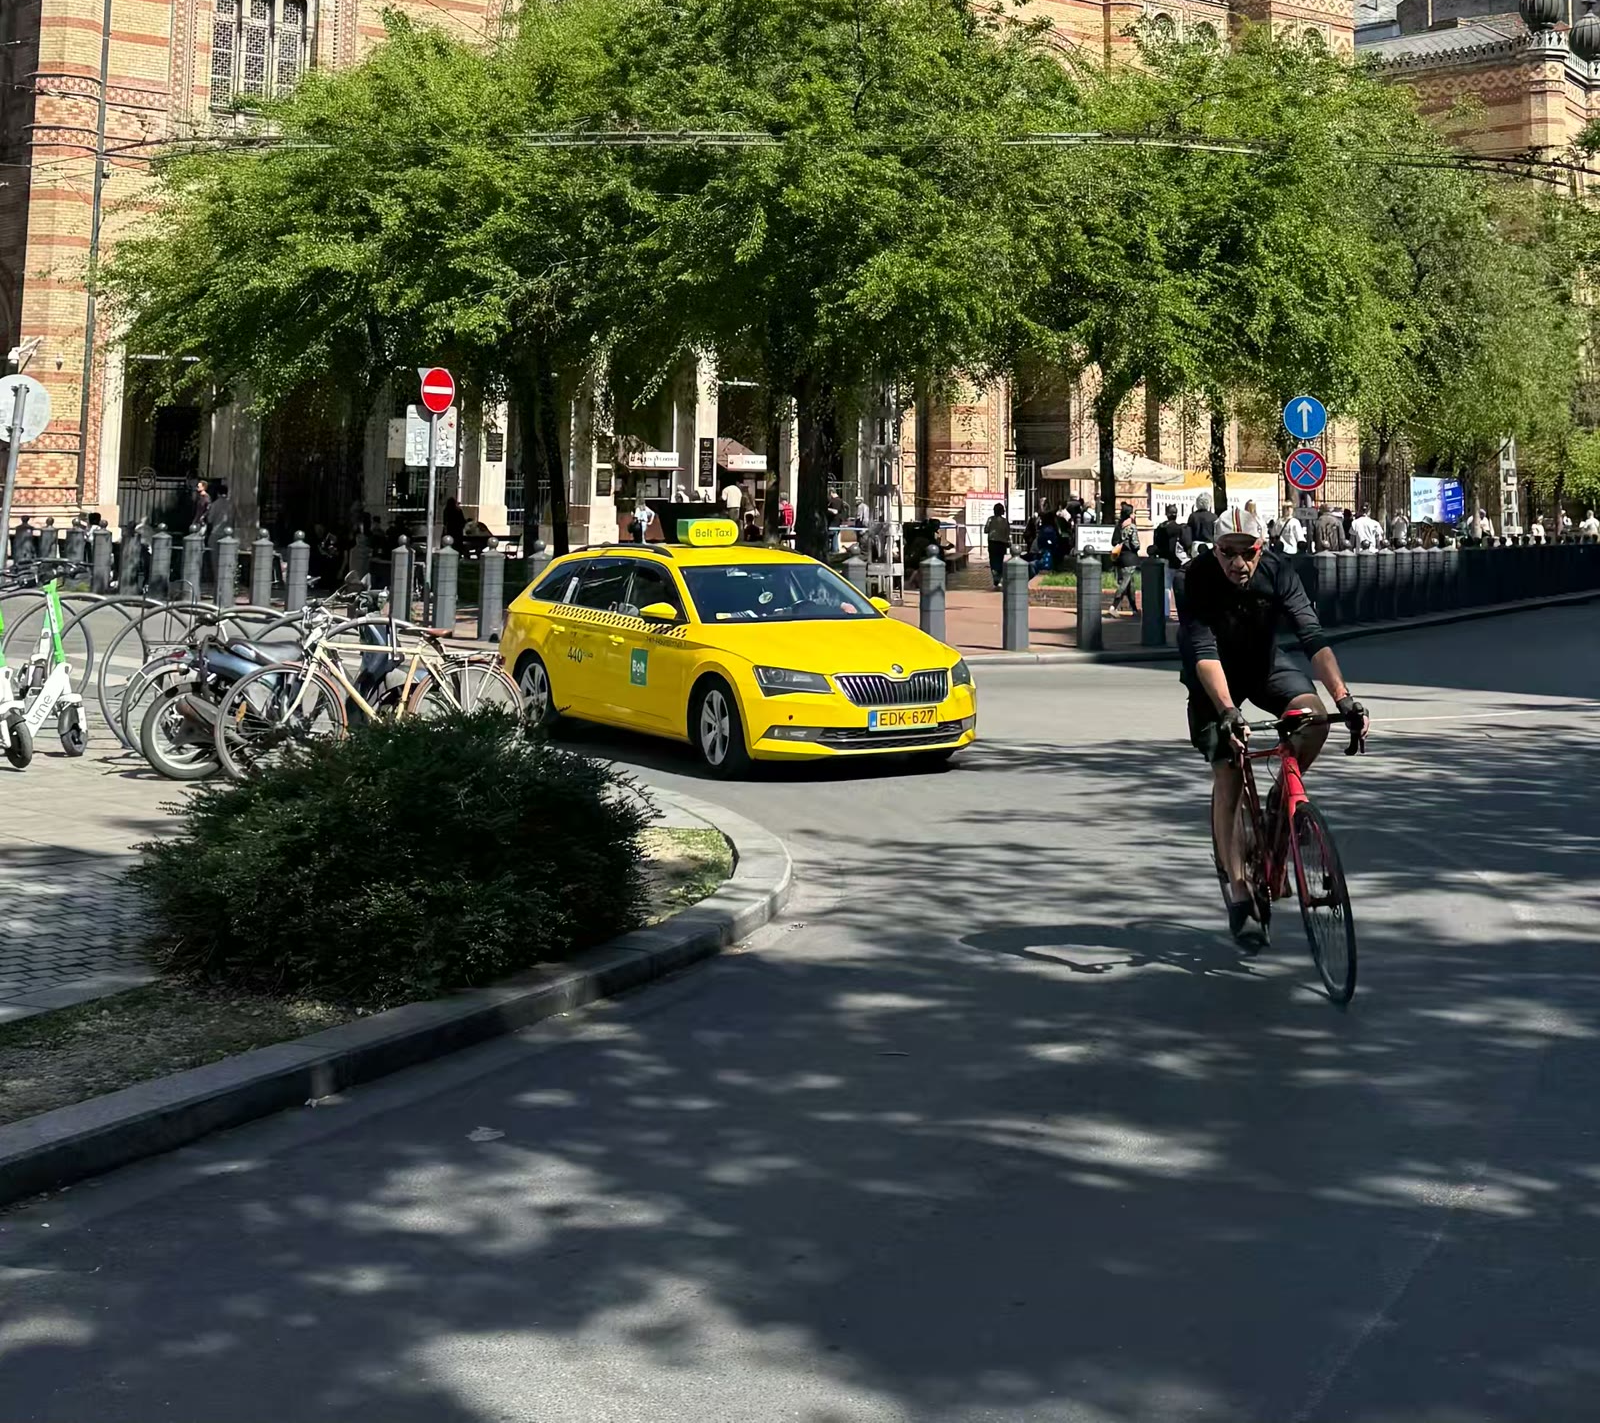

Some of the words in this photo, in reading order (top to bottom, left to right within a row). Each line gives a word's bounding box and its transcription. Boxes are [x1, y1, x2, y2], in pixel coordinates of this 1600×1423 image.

[695, 528, 712, 538] Bolt
[715, 527, 733, 538] Taxi
[567, 646, 582, 664] 440
[27, 694, 53, 726] Lime
[880, 709, 935, 726] EDK-627
